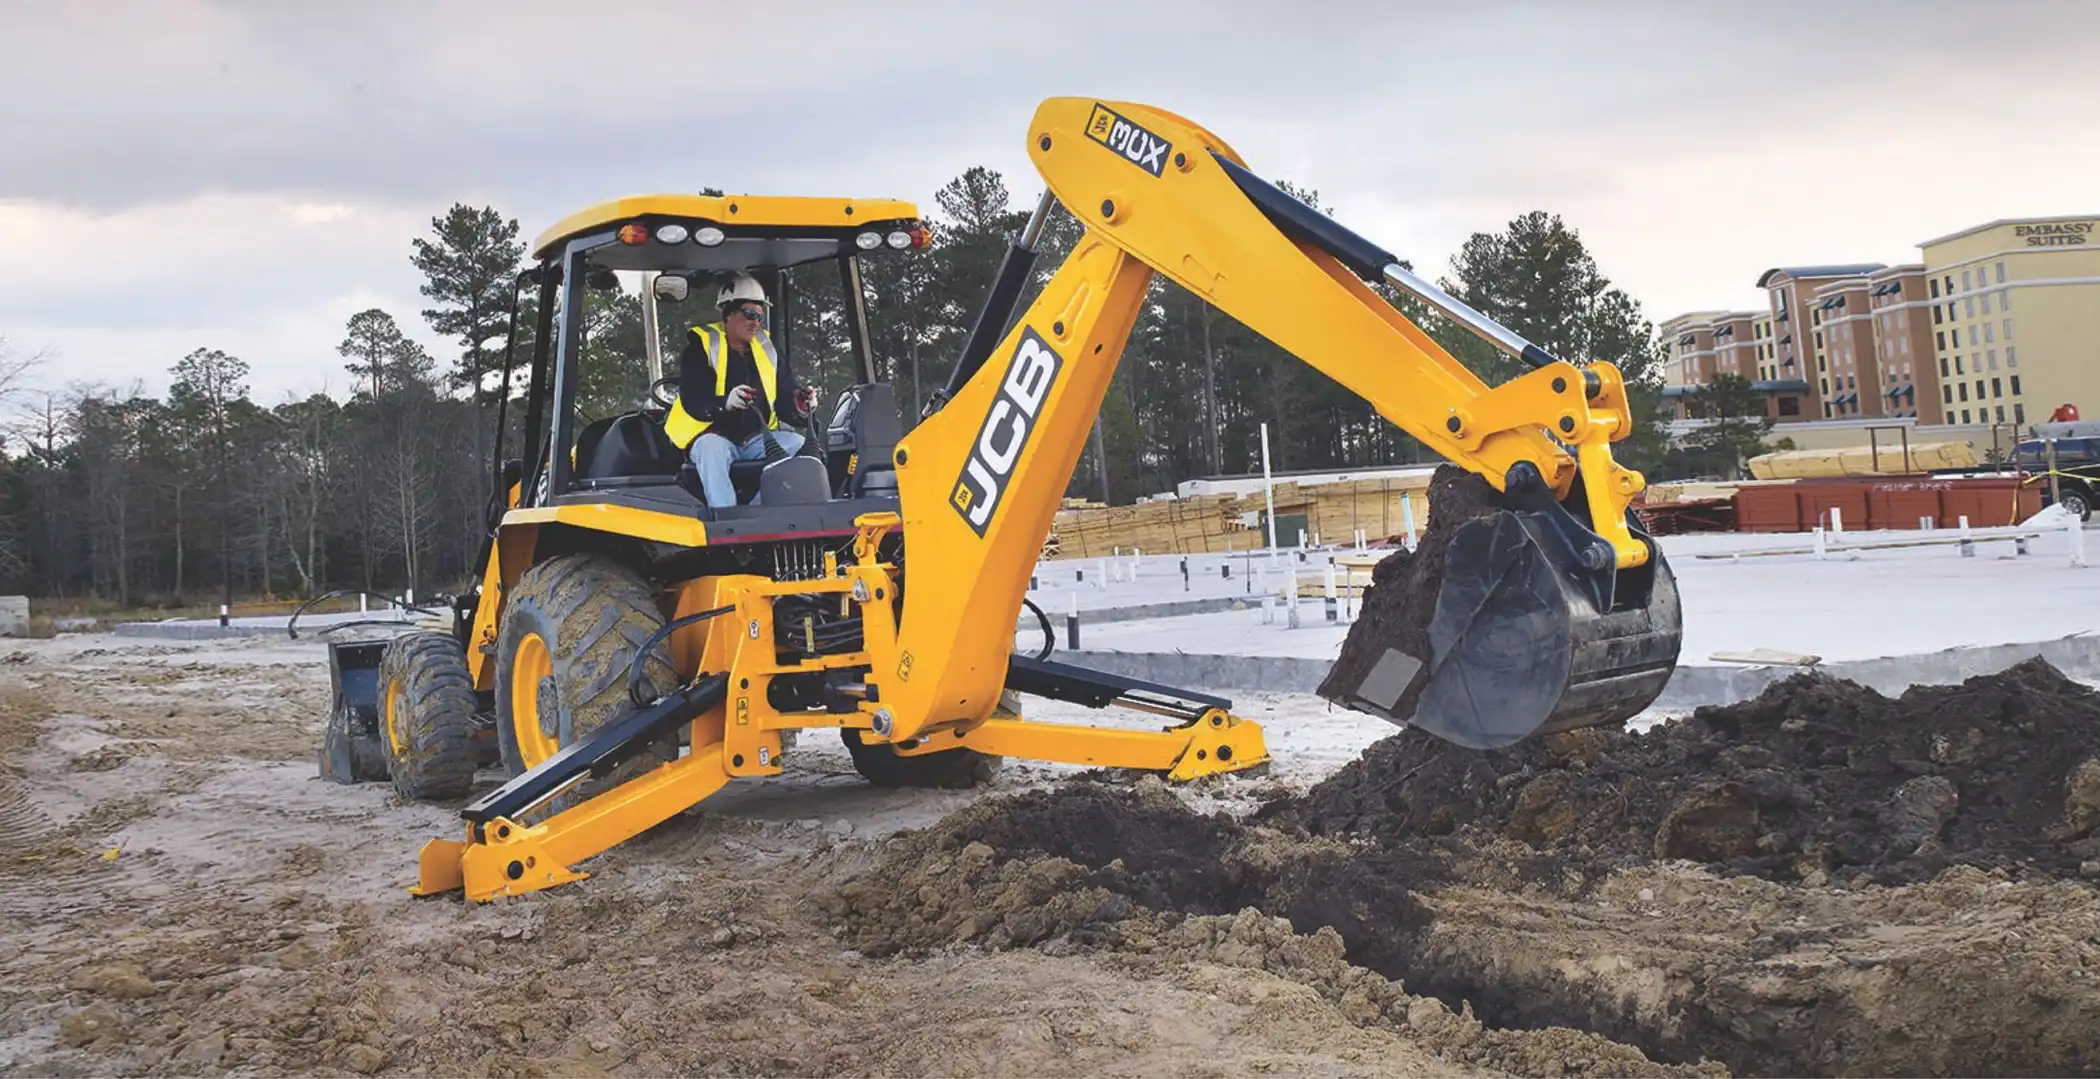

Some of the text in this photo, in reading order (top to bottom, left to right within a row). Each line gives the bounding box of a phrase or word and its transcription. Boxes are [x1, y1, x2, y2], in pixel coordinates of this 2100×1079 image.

[1109, 120, 1168, 173] 3CX
[2015, 223, 2094, 236] EMBASSY
[2027, 234, 2086, 246] SUITES
[968, 338, 1055, 526] JCB
